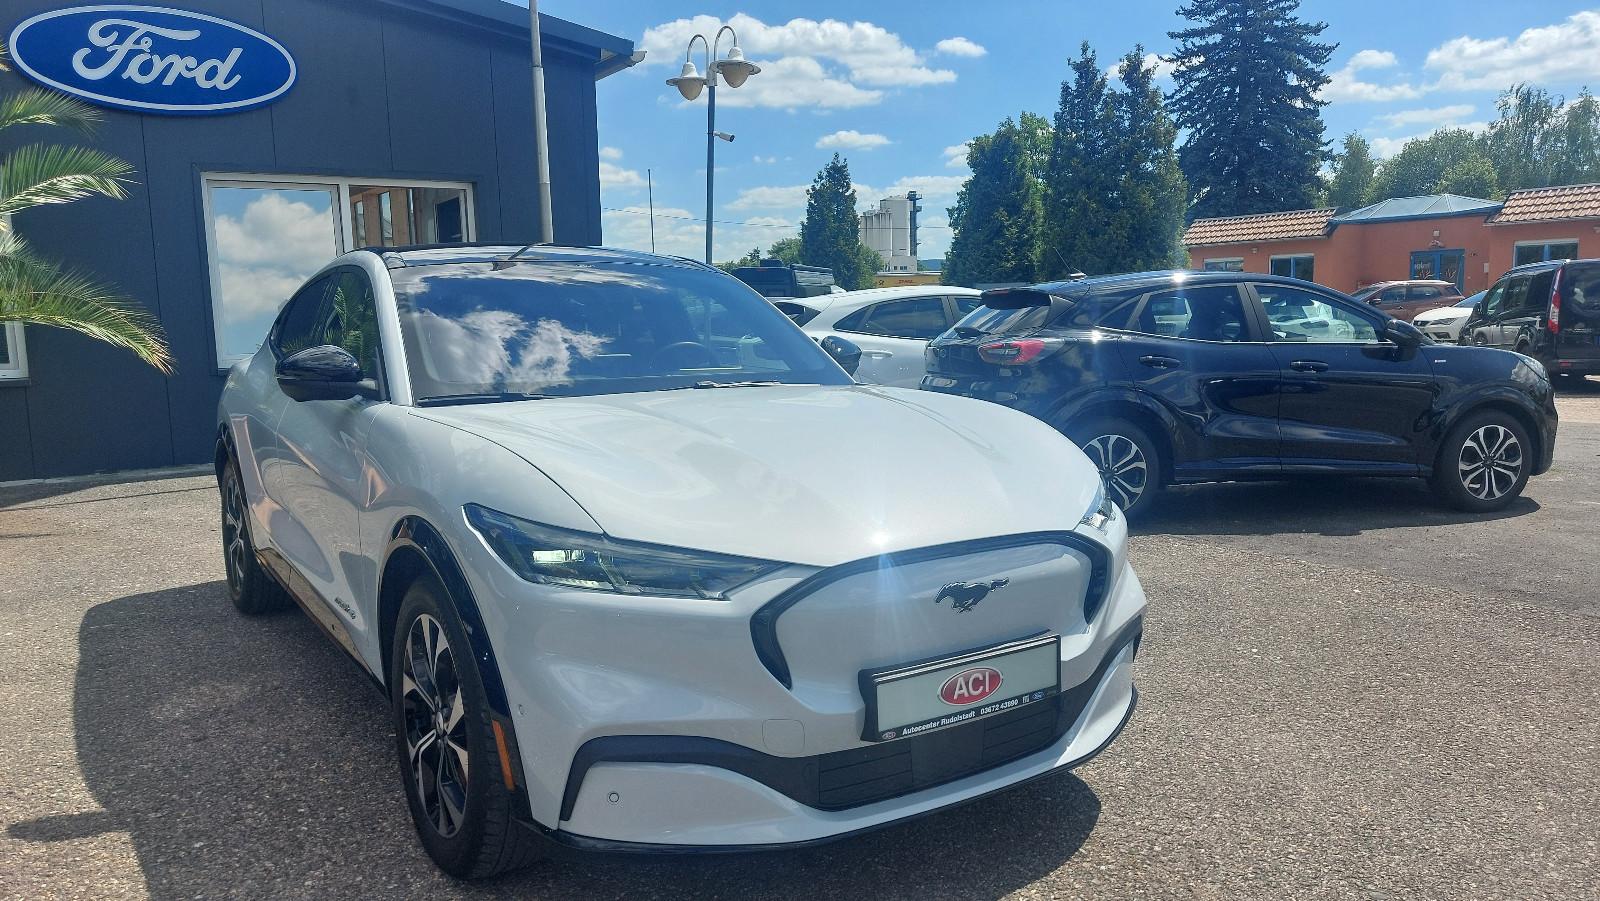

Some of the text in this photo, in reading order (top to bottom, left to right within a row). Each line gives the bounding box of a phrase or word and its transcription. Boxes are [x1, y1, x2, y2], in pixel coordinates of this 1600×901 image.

[72, 18, 243, 91] Ford
[953, 671, 990, 700] ACI
[902, 720, 940, 736] Autocenter
[941, 710, 976, 726] Rudolstadt
